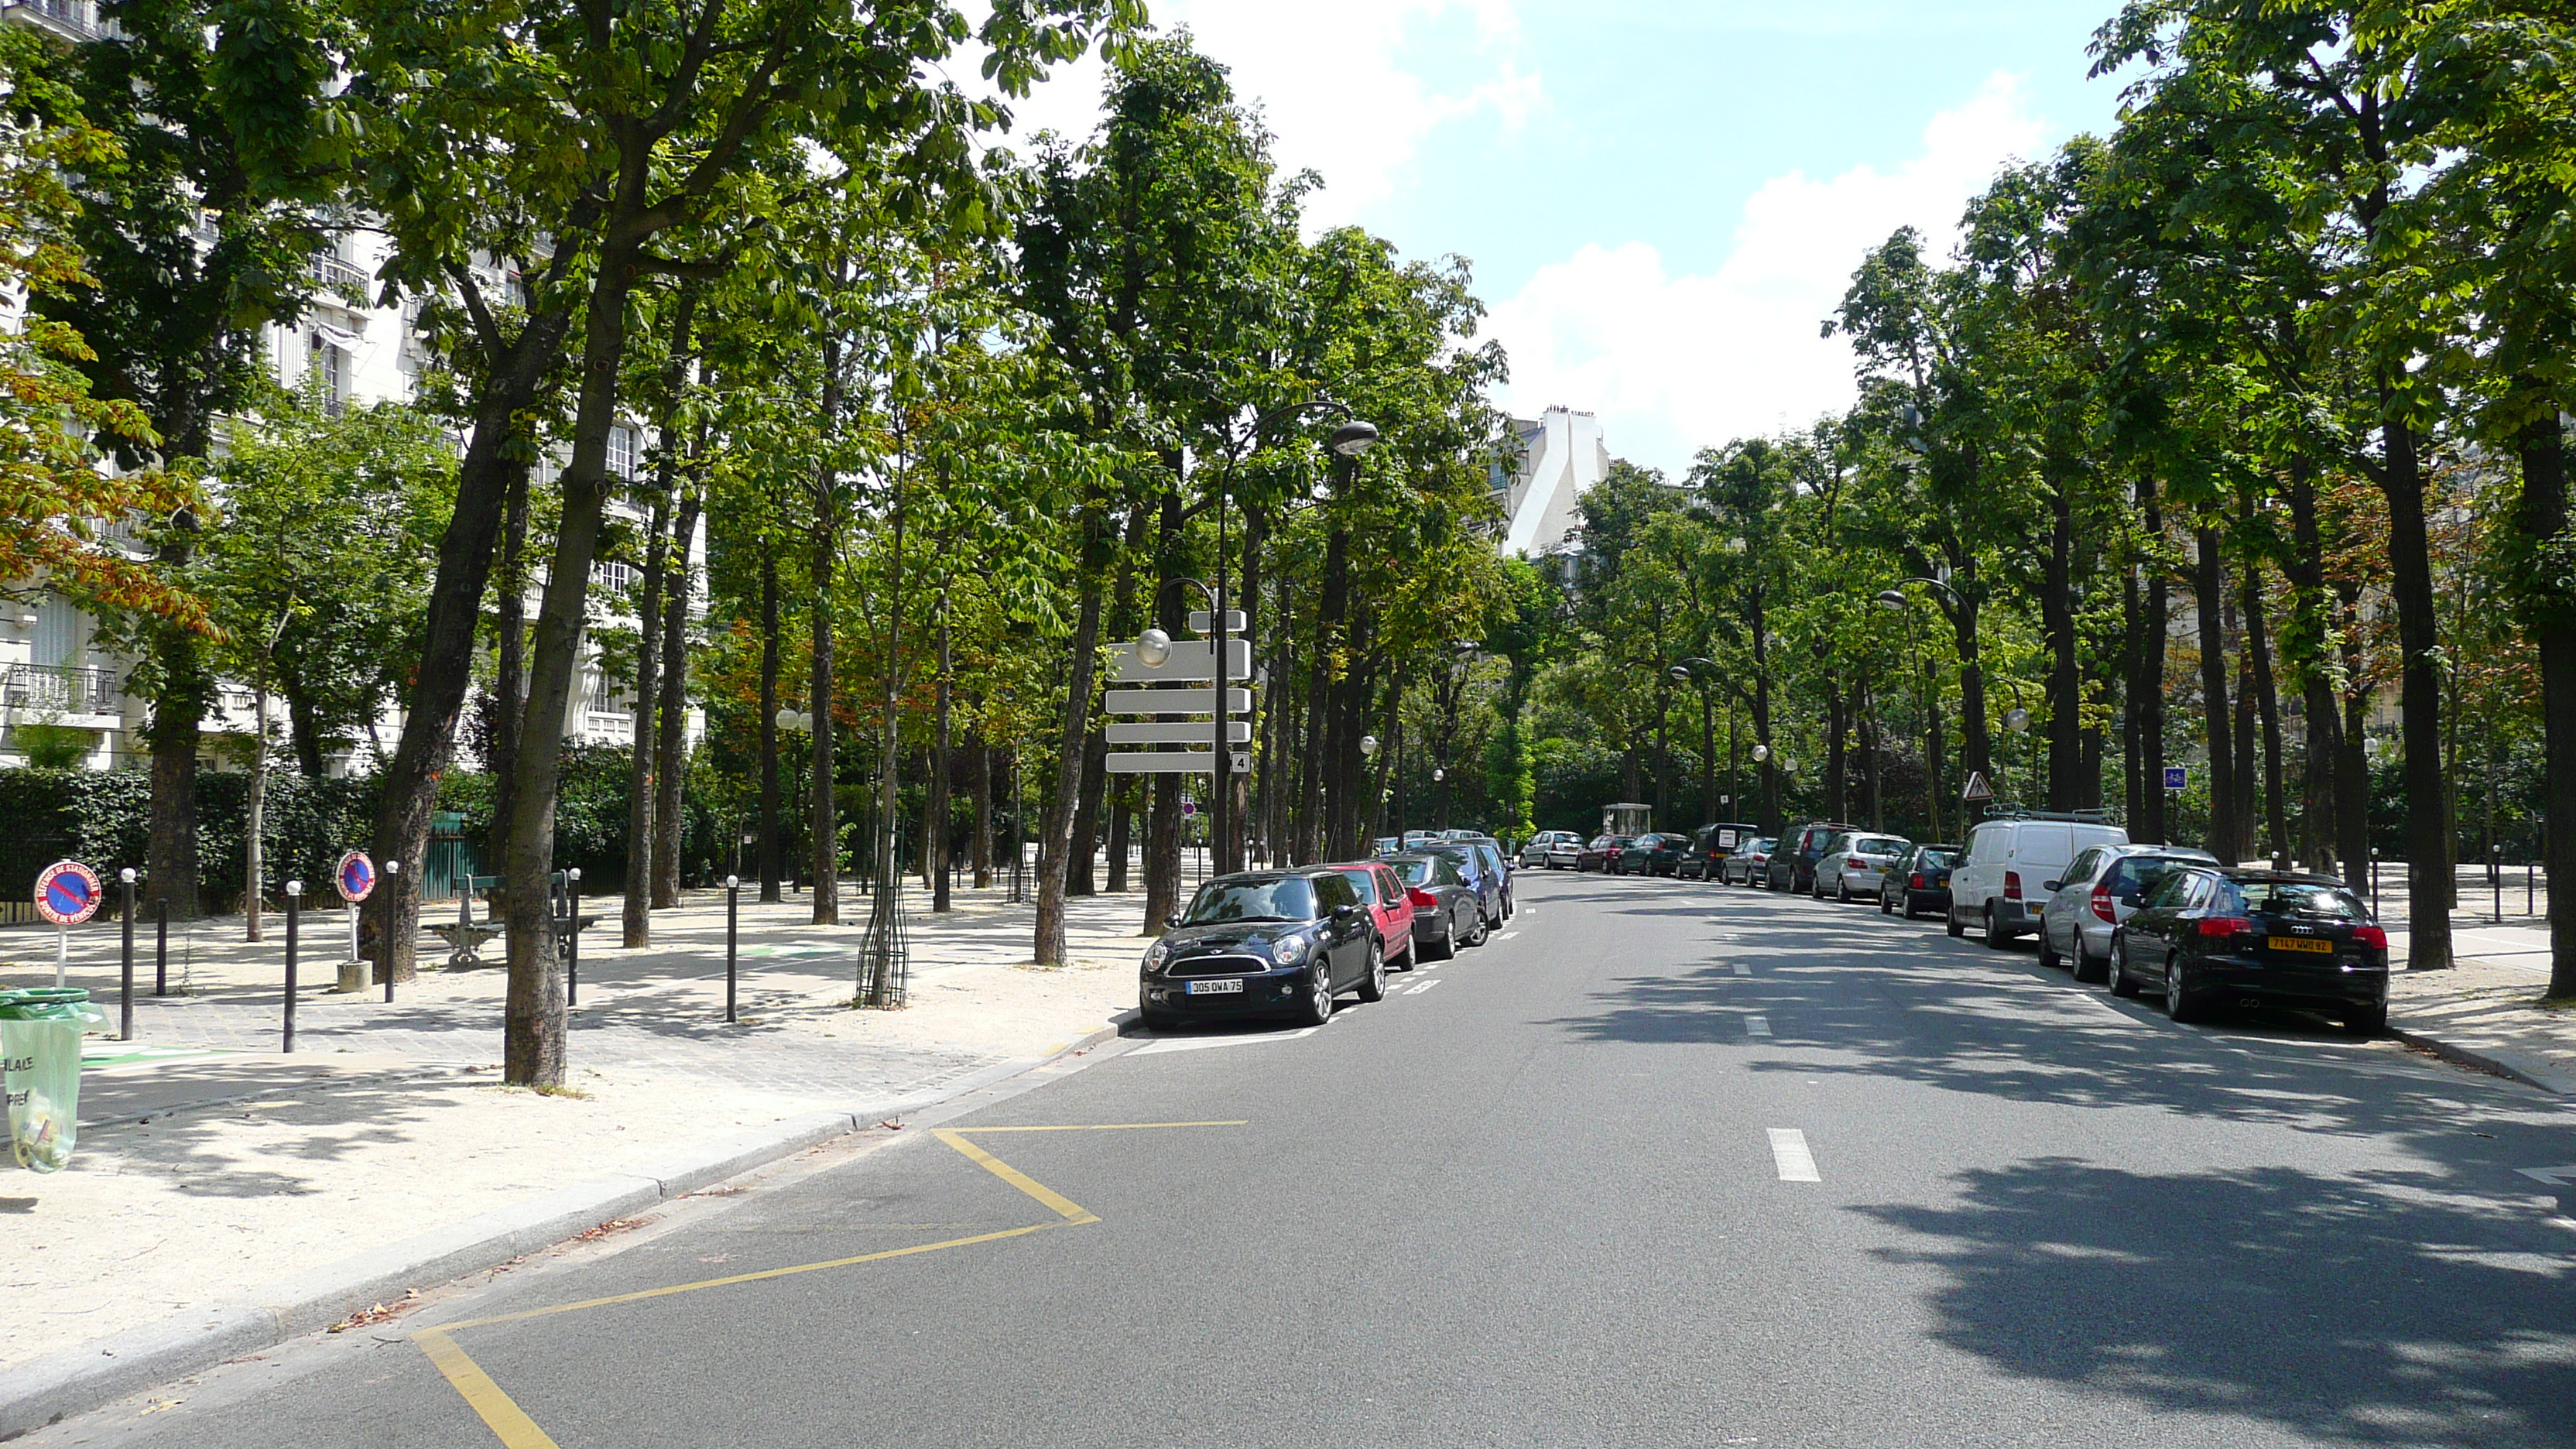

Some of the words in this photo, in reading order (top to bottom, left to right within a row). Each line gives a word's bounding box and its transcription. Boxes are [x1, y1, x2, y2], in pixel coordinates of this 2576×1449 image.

[1237, 758, 1245, 768] 4
[56, 865, 66, 874] DE
[66, 865, 98, 892] STATIONNER
[39, 901, 60, 920] SORTIE
[2273, 938, 2295, 947] 7147
[2316, 941, 2326, 951] 92
[1194, 983, 1209, 992] 305
[1231, 981, 1242, 991] 75
